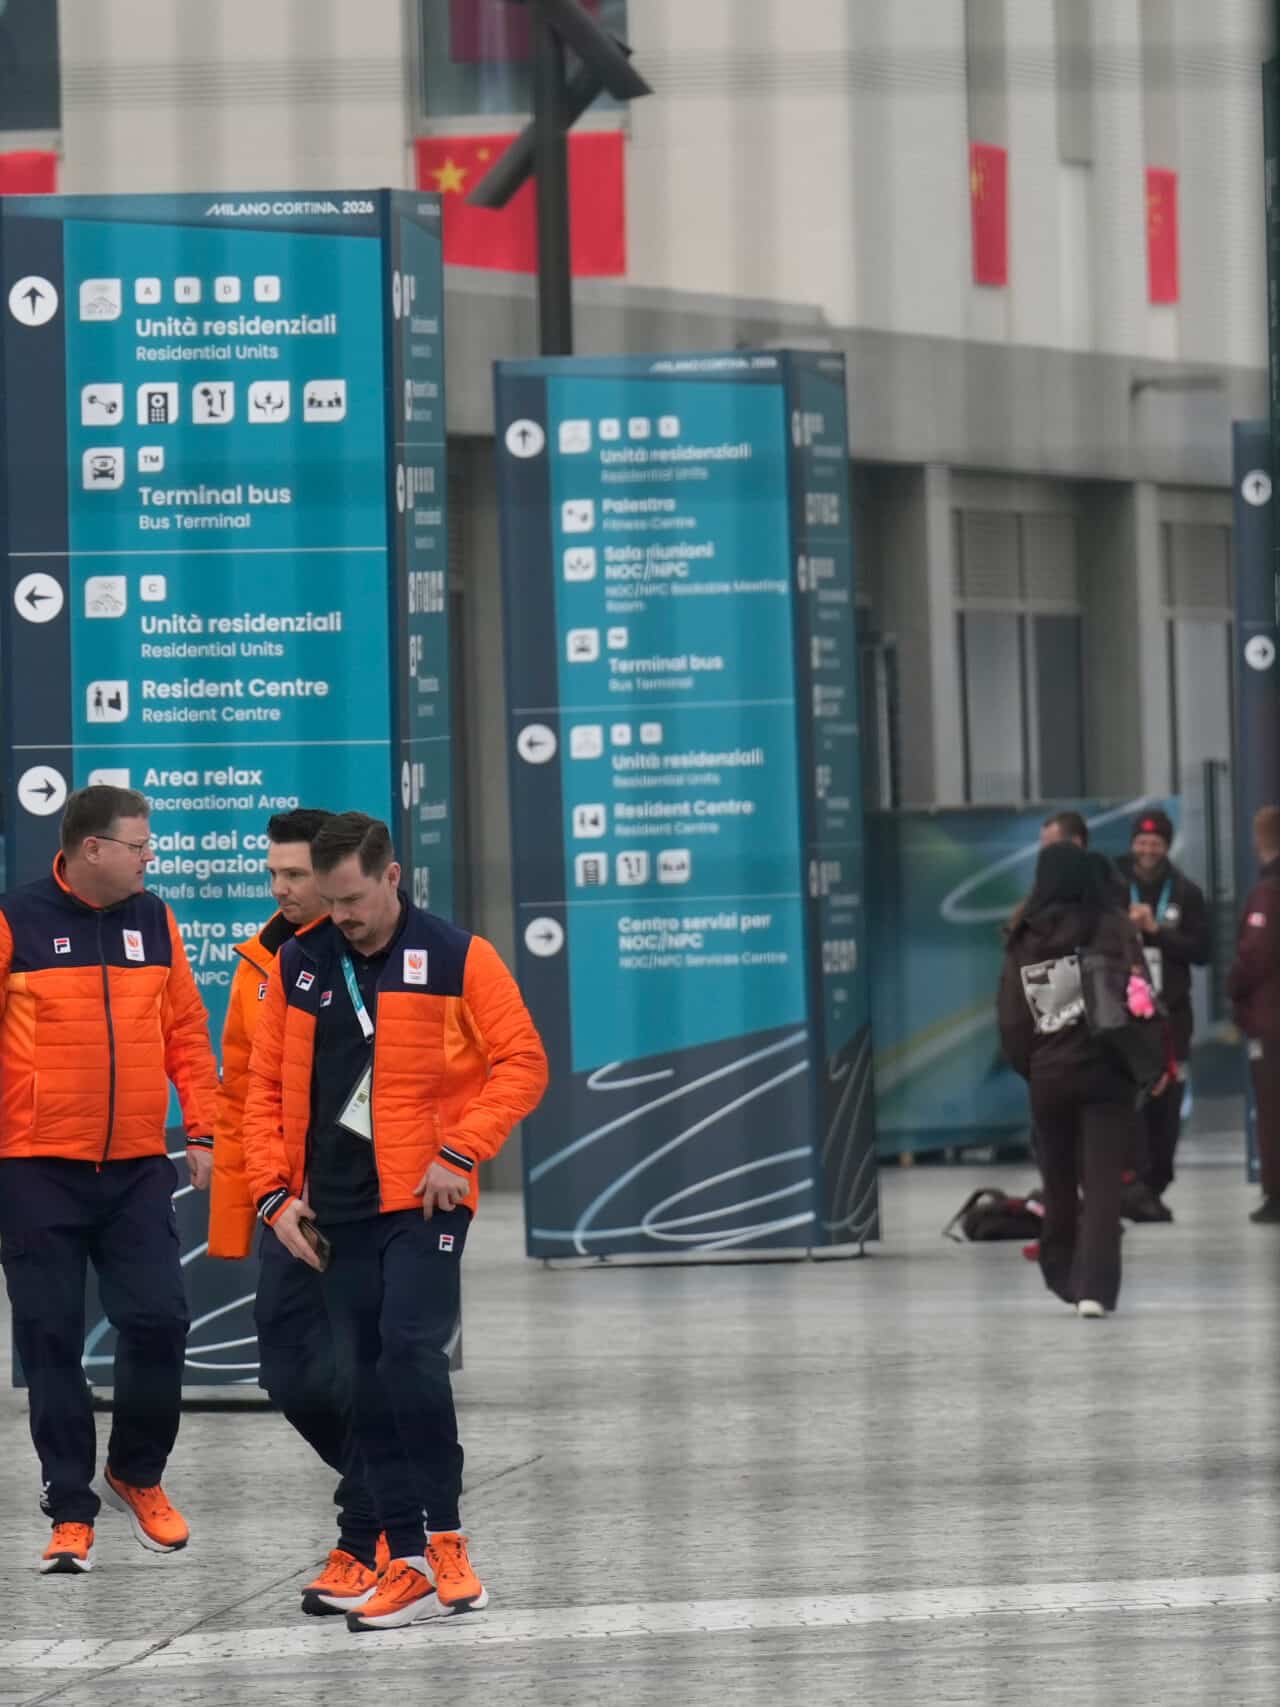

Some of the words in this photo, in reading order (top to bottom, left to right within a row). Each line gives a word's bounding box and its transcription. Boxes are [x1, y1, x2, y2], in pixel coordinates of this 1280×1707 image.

[205, 202, 270, 216] MILANO
[272, 202, 339, 215] CORTINA
[342, 201, 375, 214] 2026
[135, 316, 197, 337] Unità
[202, 314, 337, 336] residenziali
[136, 345, 232, 361] Residential
[235, 344, 279, 360] Units
[139, 486, 242, 506] Terminal
[247, 485, 291, 505] bus
[139, 515, 170, 530] Bus
[174, 513, 251, 529] Terminal
[141, 614, 203, 635] Unità
[208, 612, 341, 634] residenziali
[142, 643, 237, 658] Residential
[240, 642, 284, 657] Units
[142, 679, 244, 698] Resident
[249, 678, 328, 697] Centre
[142, 707, 217, 722] Resident
[222, 706, 281, 721] Centre
[144, 768, 199, 787] Area
[204, 767, 262, 786] relax
[257, 795, 299, 810] Area
[148, 832, 195, 850] Sala
[201, 831, 238, 850] dei
[145, 854, 269, 880] delegazio
[200, 883, 223, 898] de
[228, 882, 272, 898] Missi
[178, 920, 226, 937] ntro
